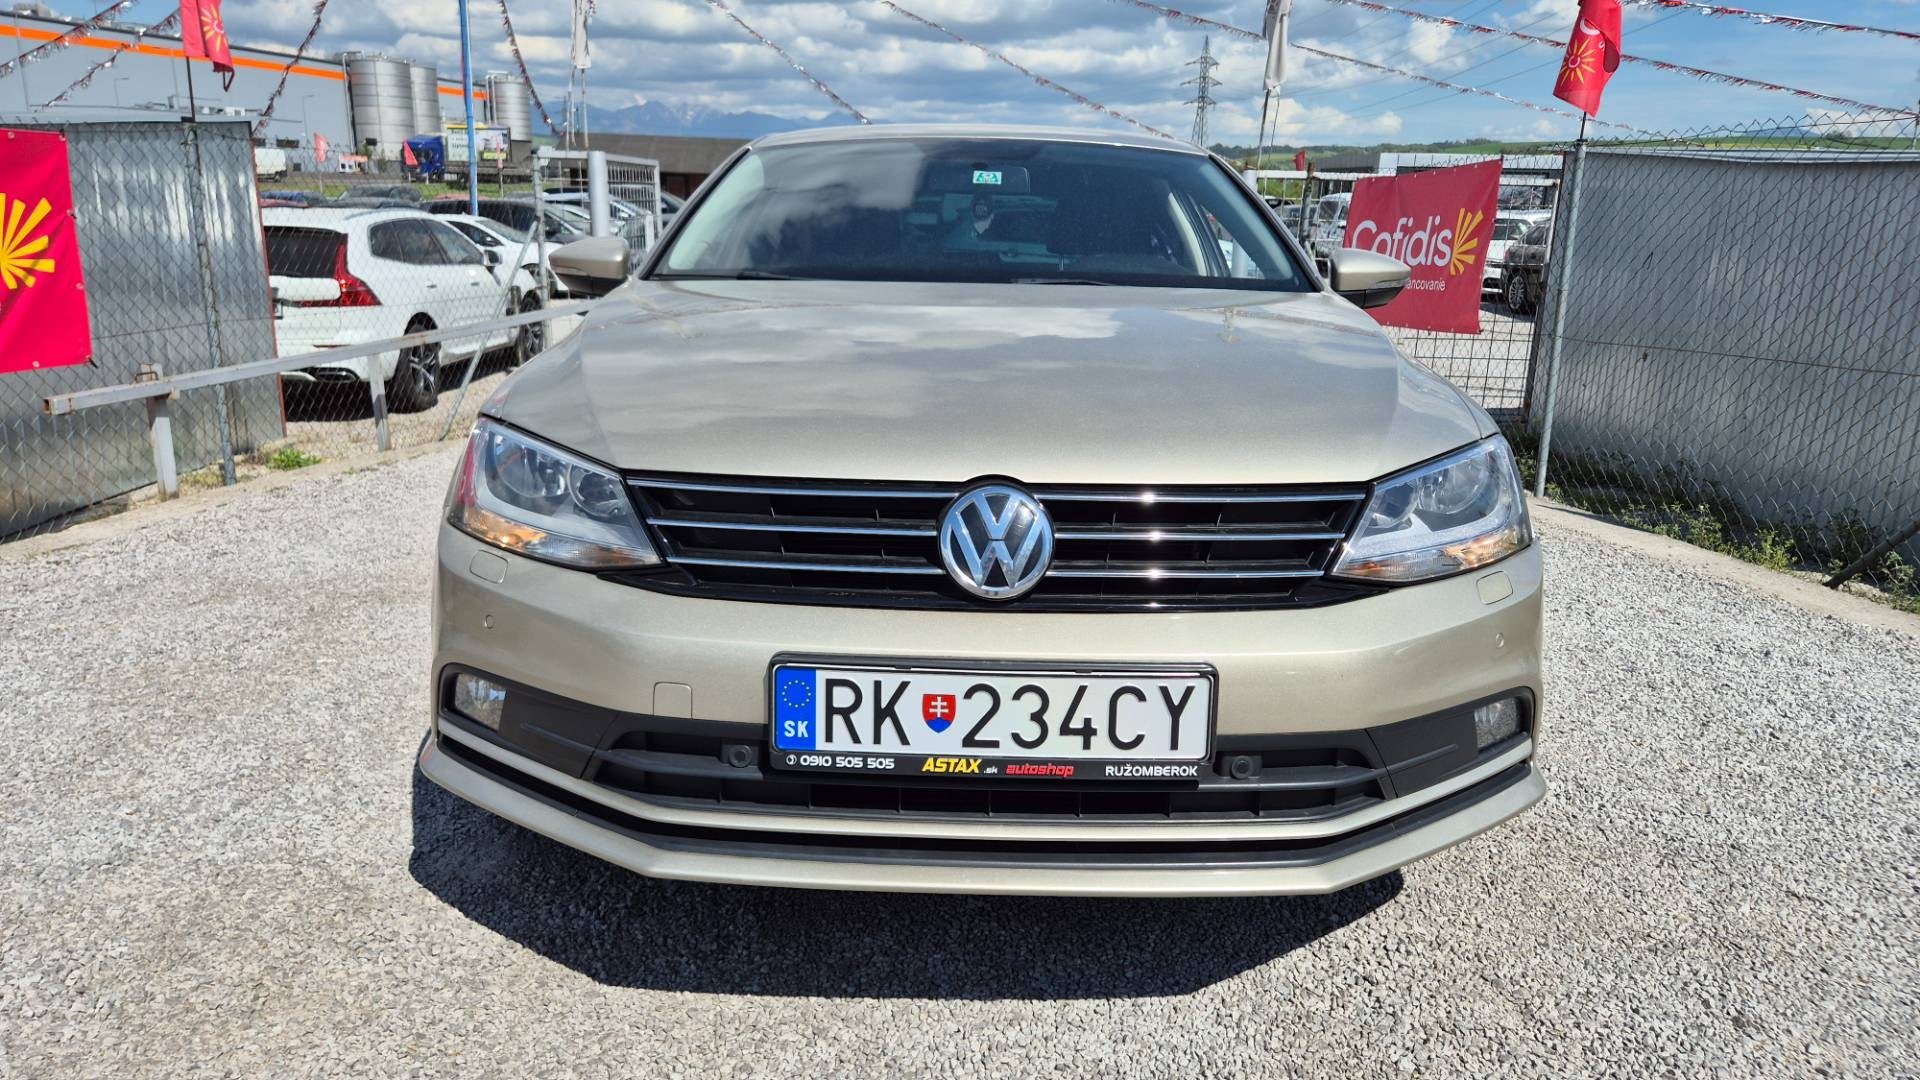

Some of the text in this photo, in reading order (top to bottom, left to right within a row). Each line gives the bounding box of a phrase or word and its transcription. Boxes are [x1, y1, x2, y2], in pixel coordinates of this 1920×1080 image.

[1352, 215, 1452, 267] Cofidis
[1406, 277, 1446, 291] ancovanie
[824, 678, 1196, 751] RK 234CY
[783, 720, 809, 738] SK
[800, 754, 832, 768] 0910
[835, 756, 864, 769] 505
[867, 757, 895, 770] 505
[1006, 763, 1075, 778] autoshop
[1105, 763, 1199, 777] RUŽOMBEROK
